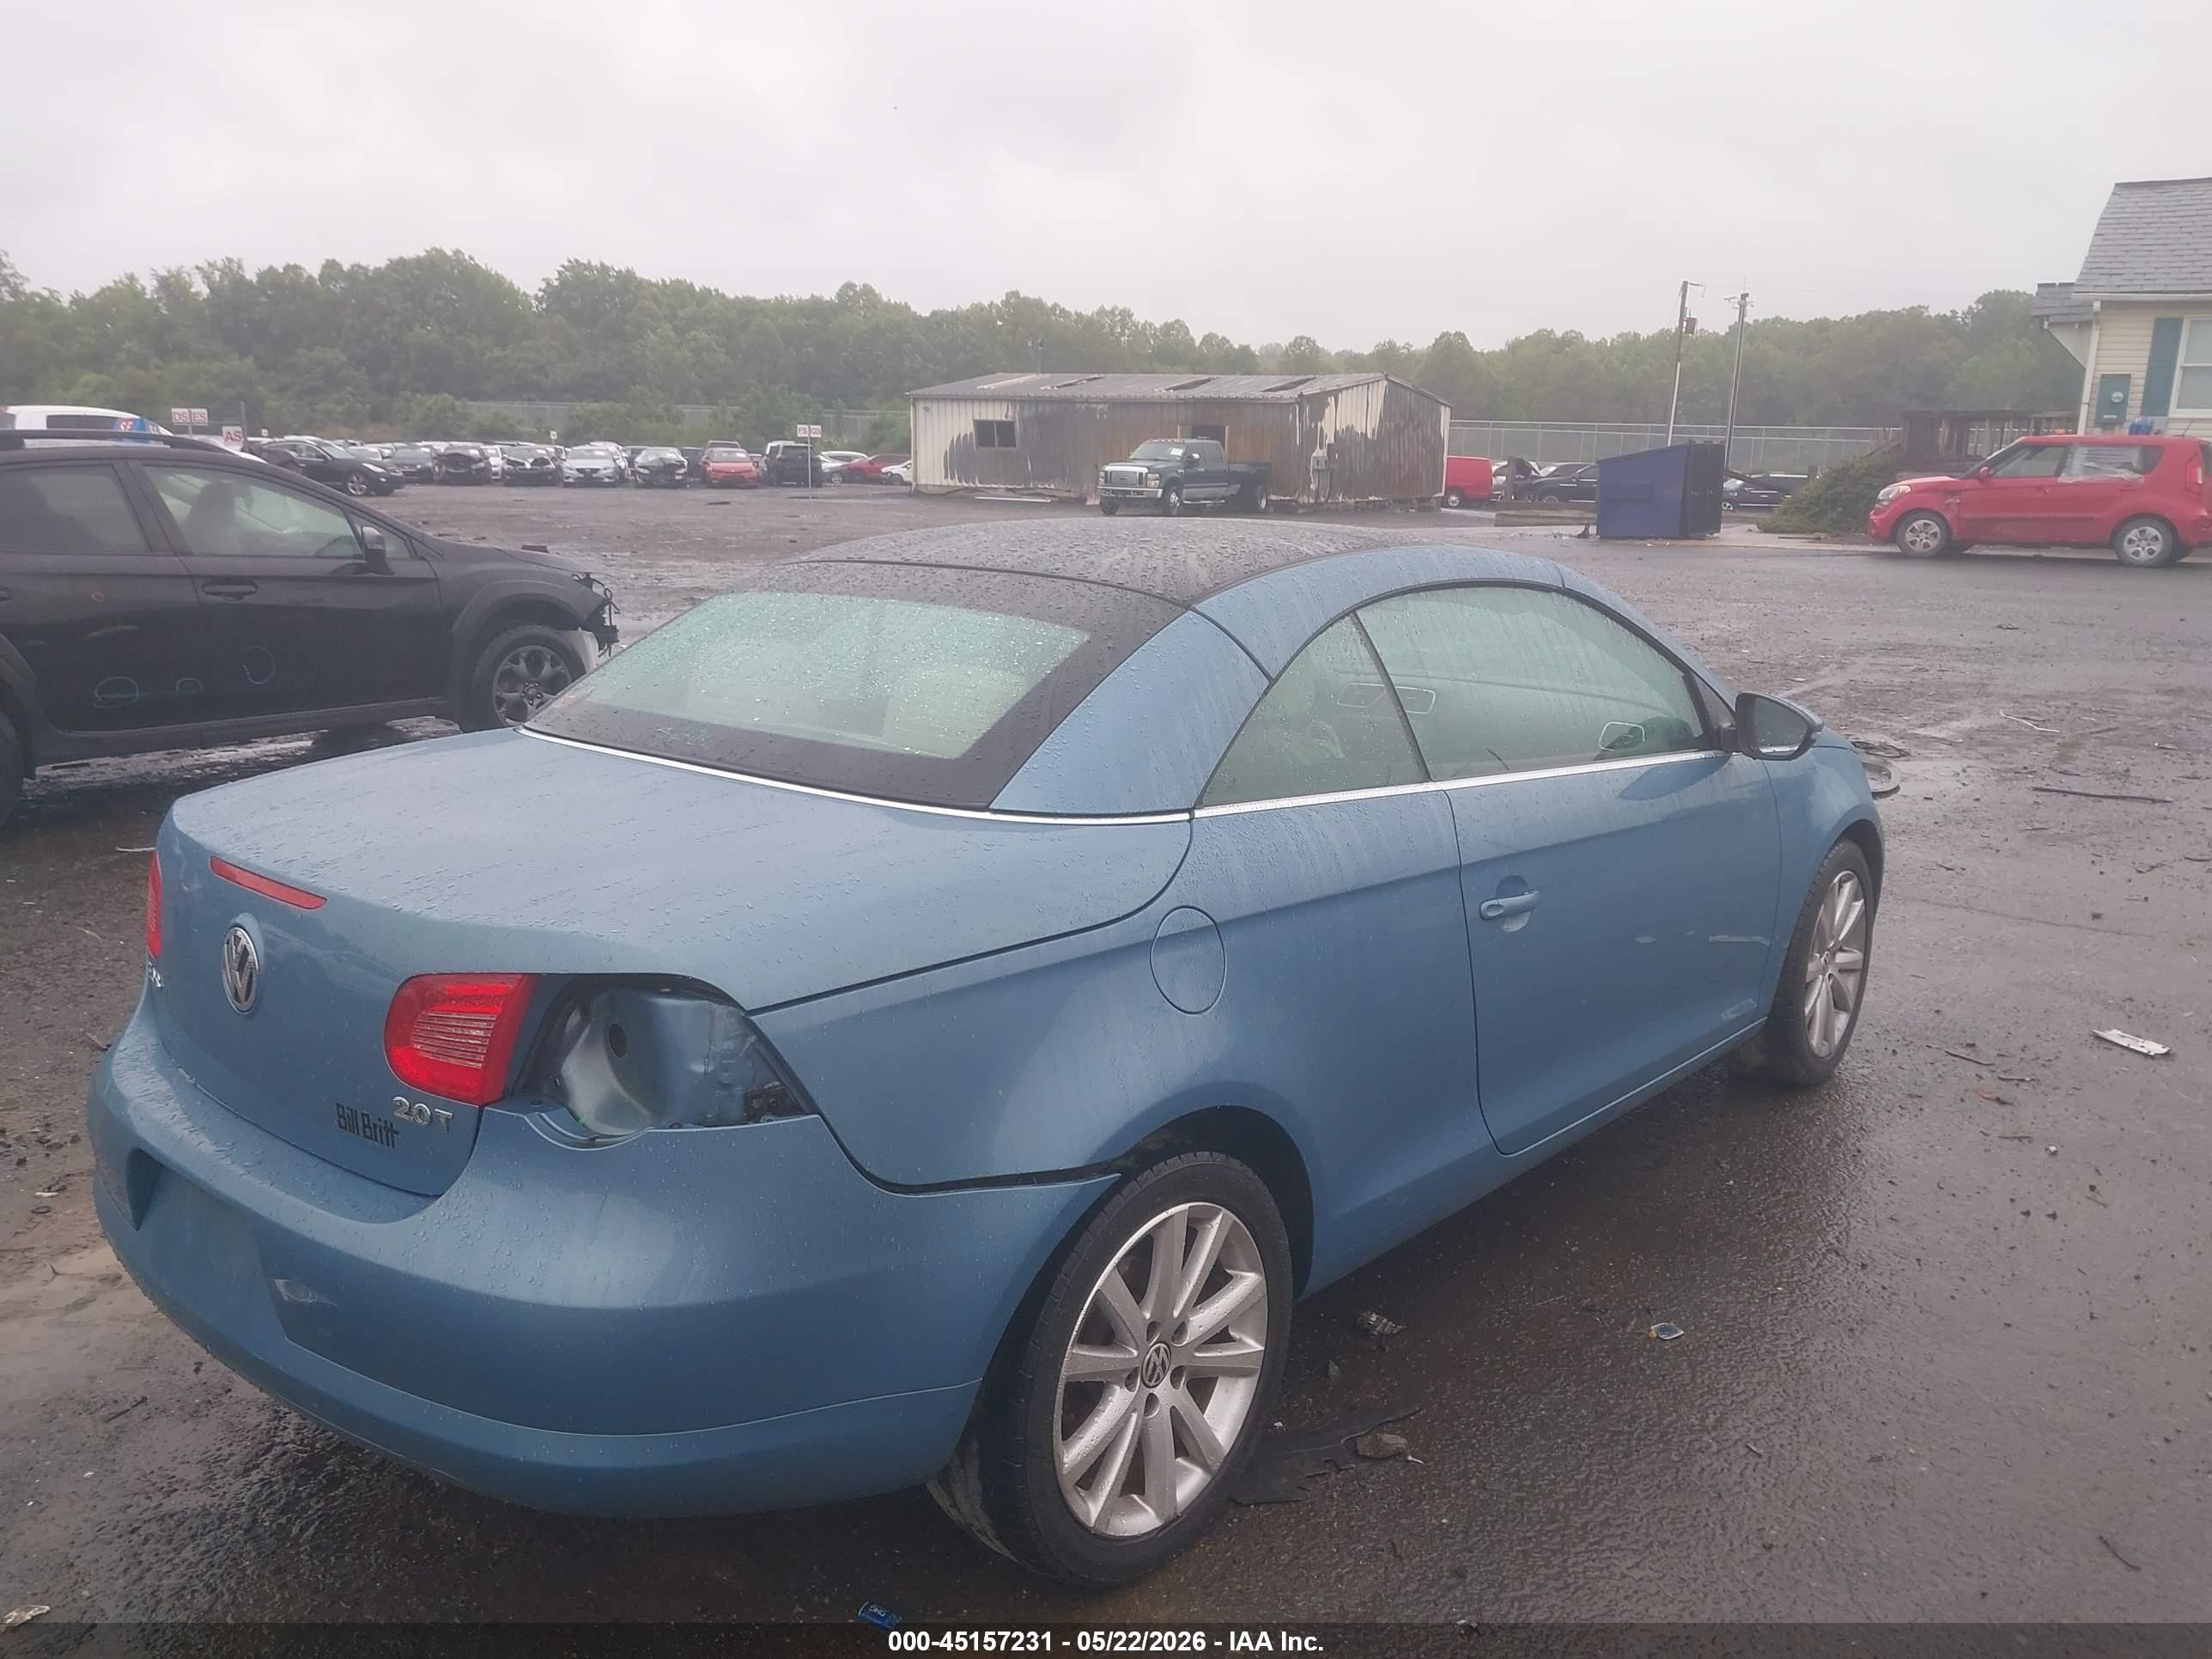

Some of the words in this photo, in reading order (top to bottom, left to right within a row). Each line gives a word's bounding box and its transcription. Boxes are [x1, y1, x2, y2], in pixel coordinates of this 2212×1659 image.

[225, 431, 242, 441] AS
[336, 1103, 360, 1136] Bill
[362, 1112, 400, 1149] Britt
